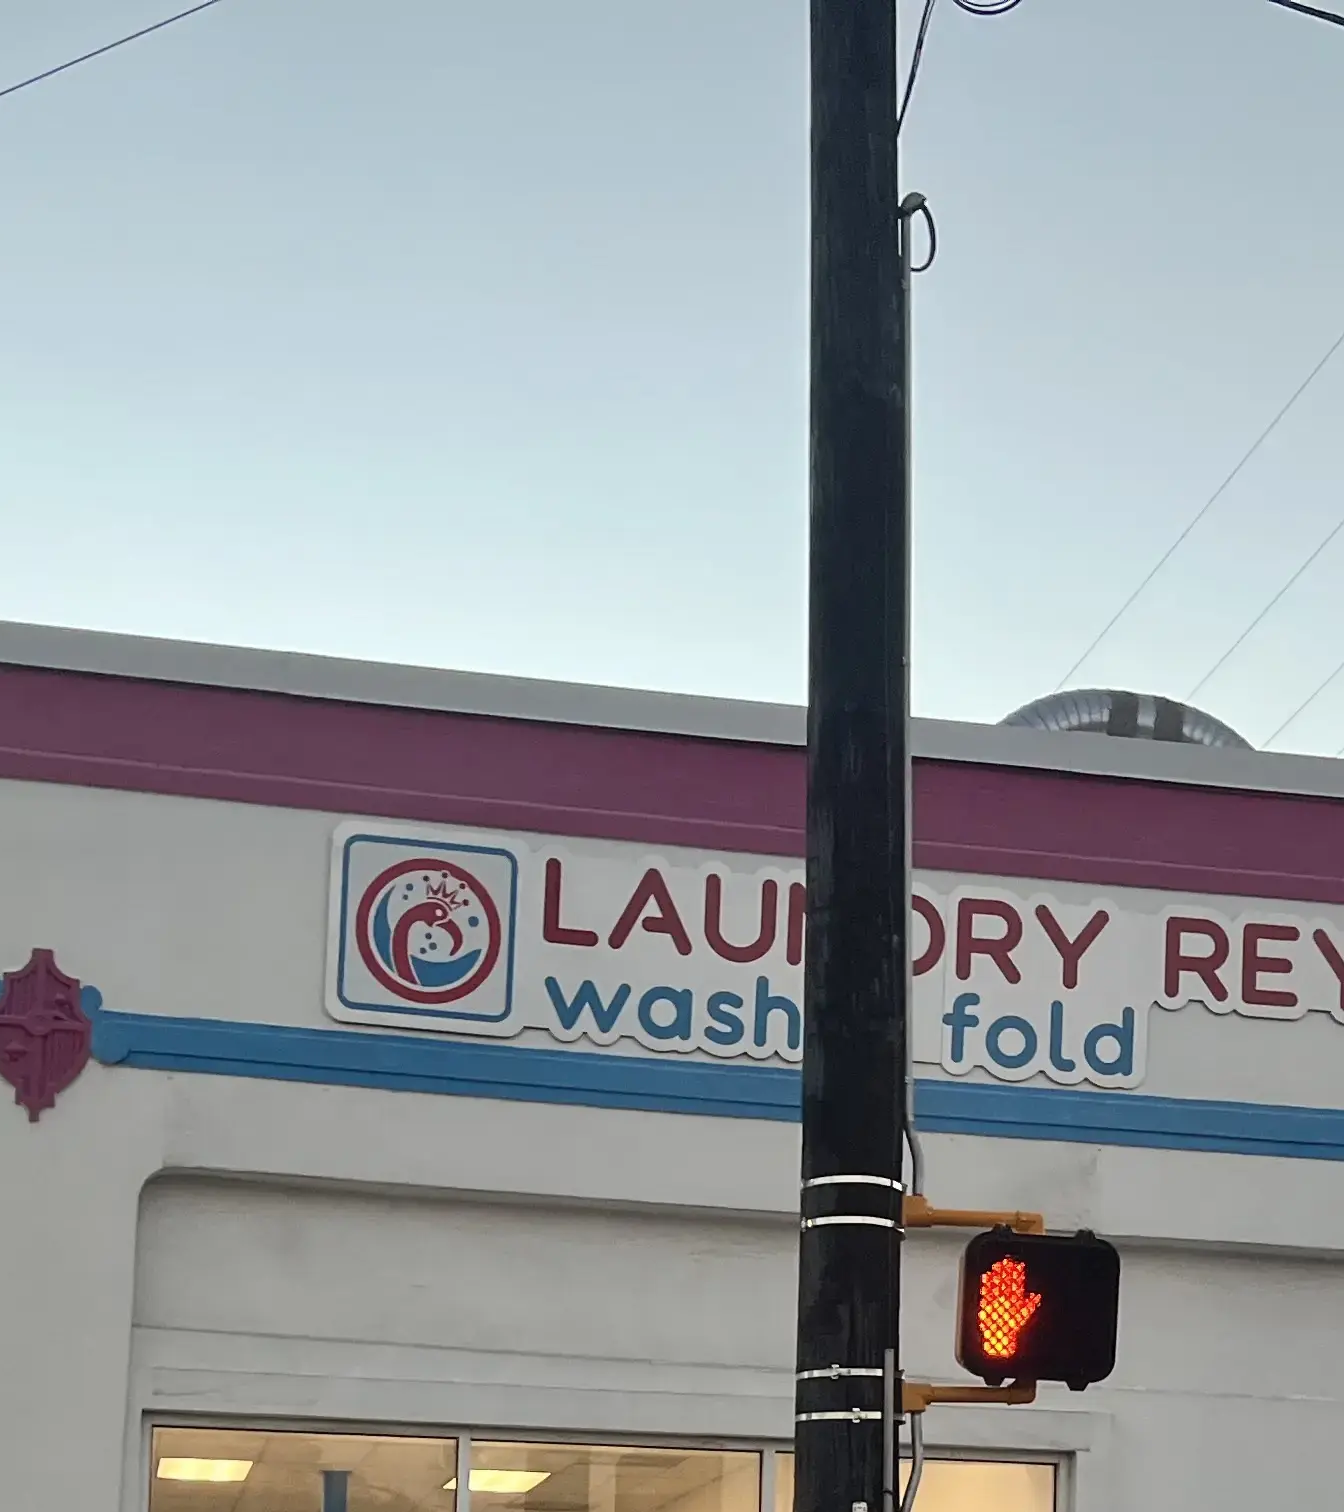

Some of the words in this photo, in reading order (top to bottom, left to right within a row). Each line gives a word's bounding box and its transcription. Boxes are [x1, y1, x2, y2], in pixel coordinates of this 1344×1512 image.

[543, 857, 1110, 989] LAURY
[544, 975, 801, 1050] wash
[942, 992, 1135, 1077] fold
